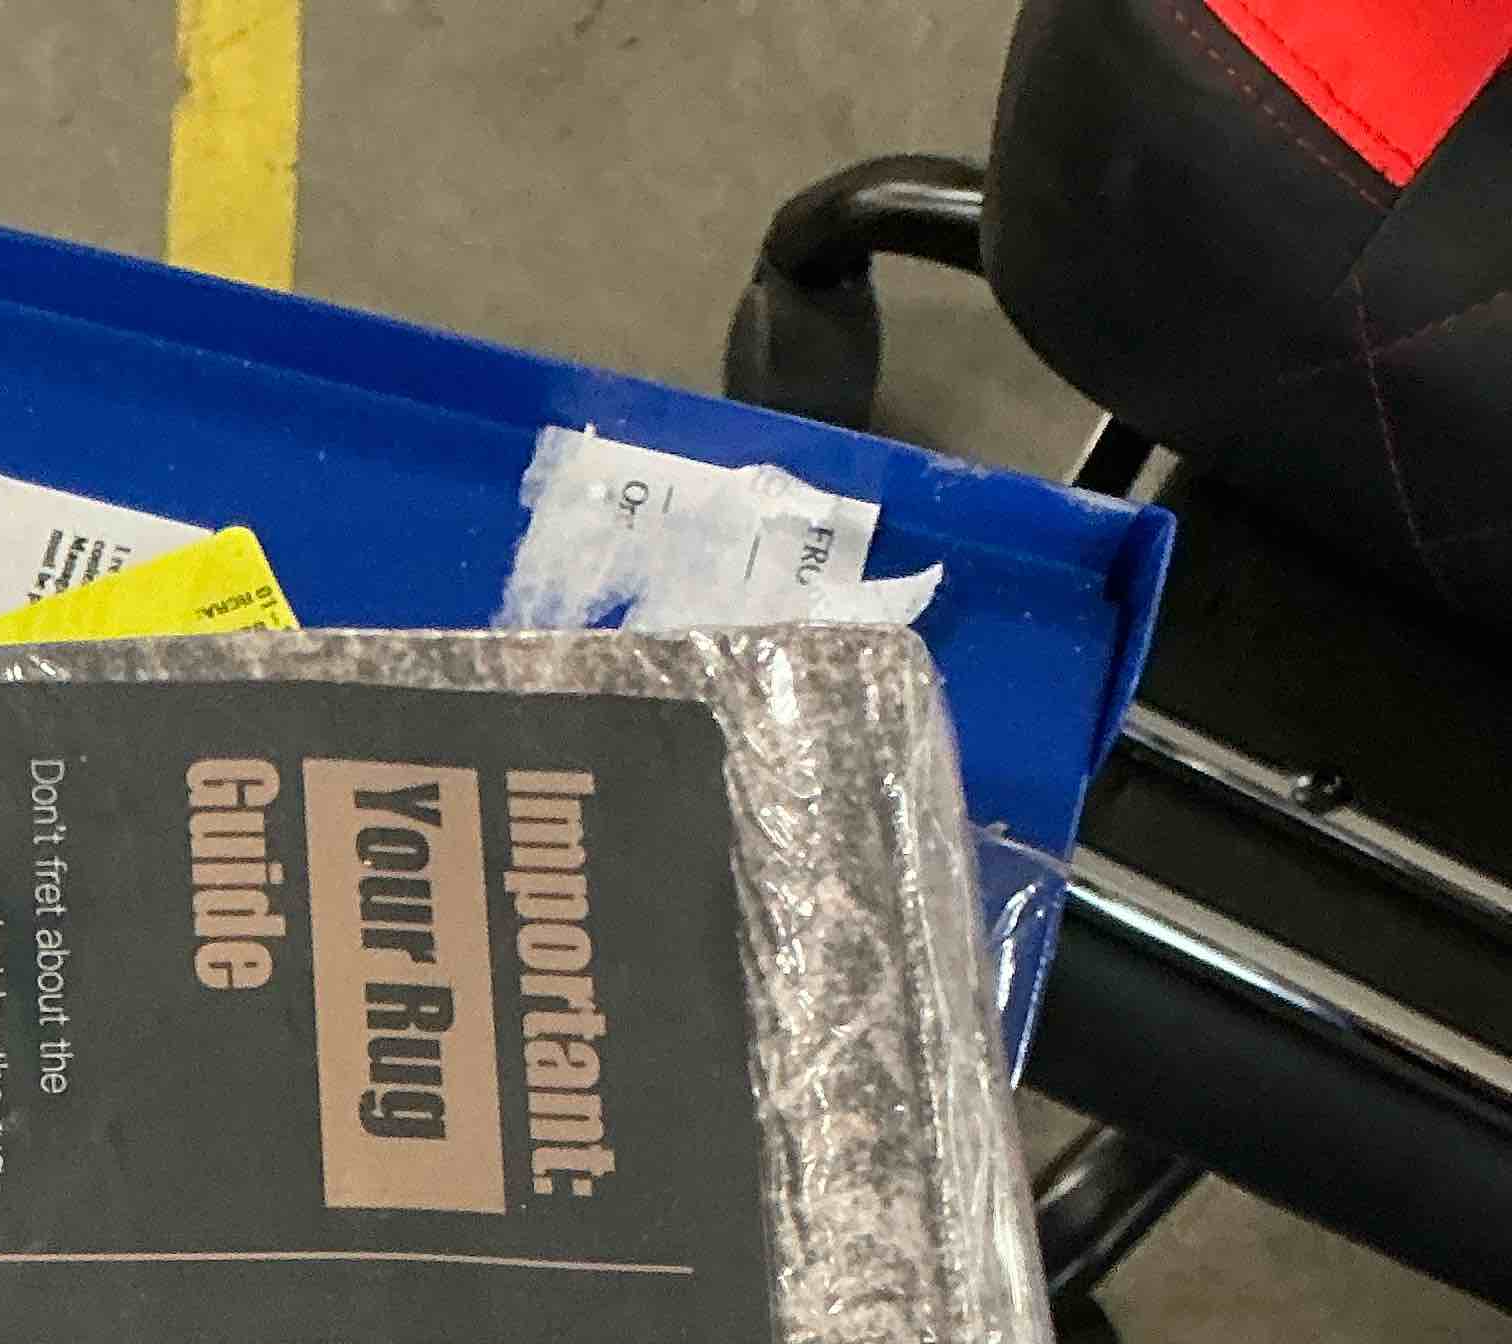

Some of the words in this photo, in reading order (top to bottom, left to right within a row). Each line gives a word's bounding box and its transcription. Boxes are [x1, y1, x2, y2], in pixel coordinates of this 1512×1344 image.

[31, 759, 66, 844] Don't
[35, 856, 68, 917] fret
[186, 758, 286, 990] Guide
[353, 782, 442, 964] Your
[35, 928, 71, 1026] about
[504, 768, 616, 1196] Important:
[40, 1038, 74, 1094] the
[358, 982, 456, 1141] Rug
